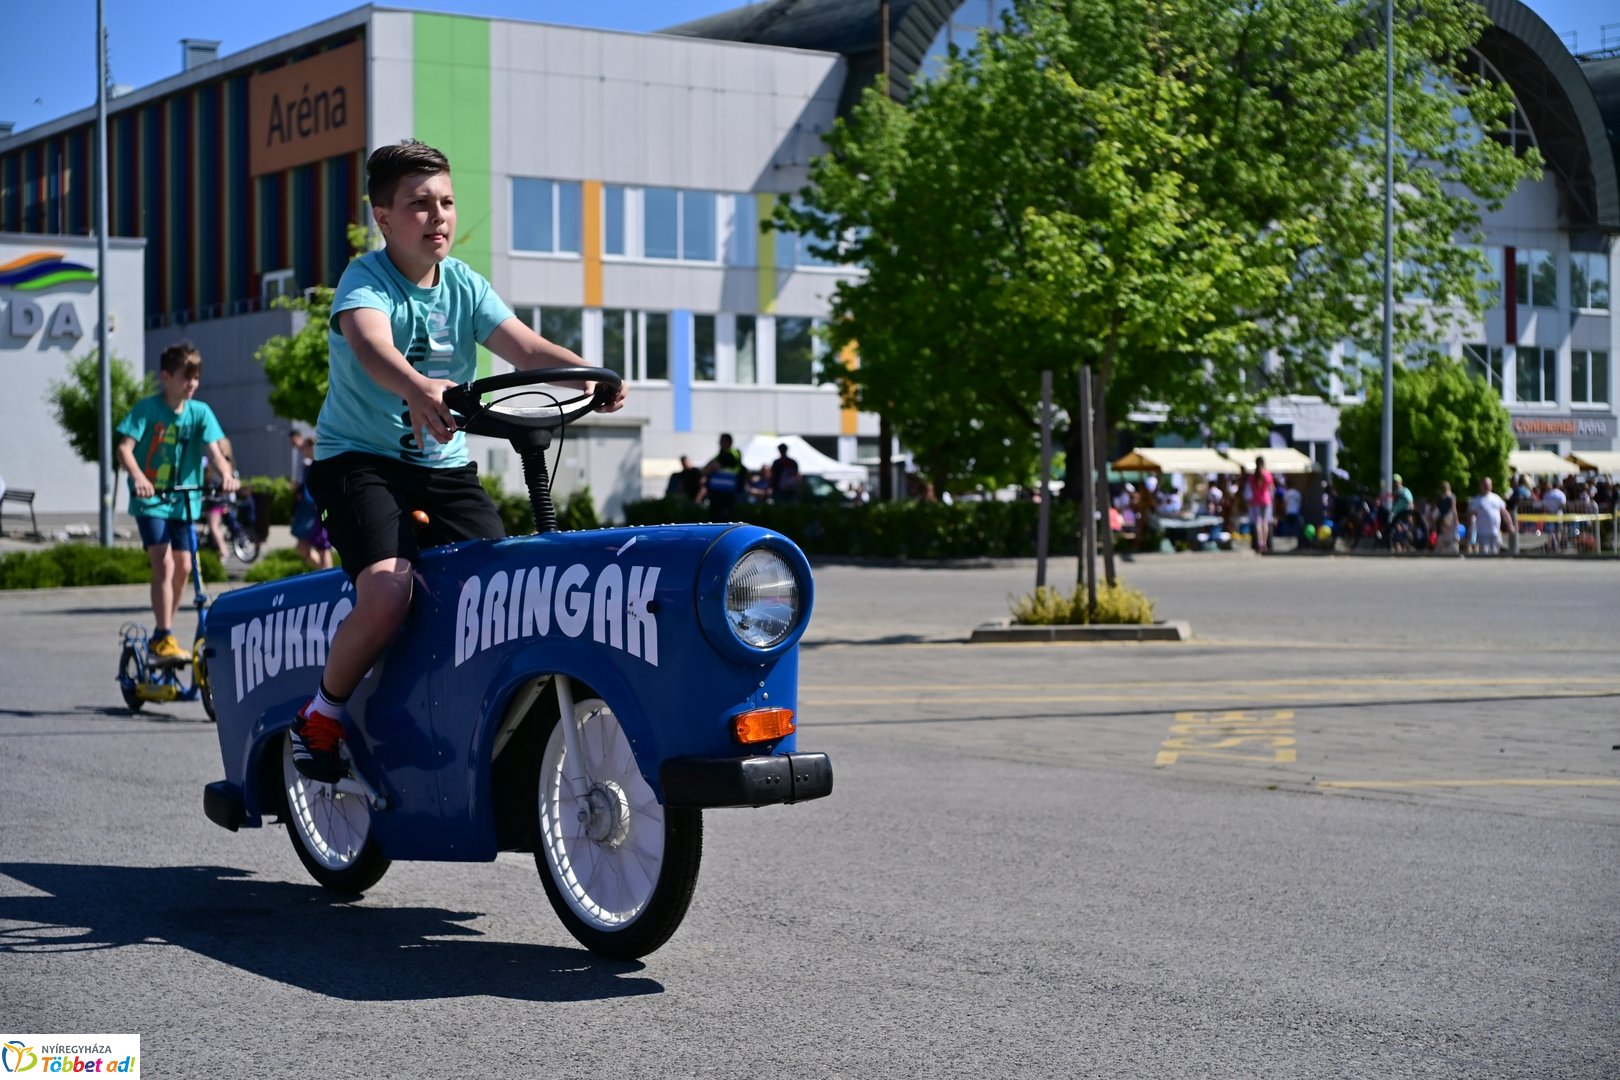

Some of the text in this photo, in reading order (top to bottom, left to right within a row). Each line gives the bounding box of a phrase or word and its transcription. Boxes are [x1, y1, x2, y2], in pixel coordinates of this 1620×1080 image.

[266, 82, 347, 148] Aréna
[0, 298, 84, 338] DA
[1515, 418, 1576, 434] Continental
[454, 535, 662, 667] BRINGÁK
